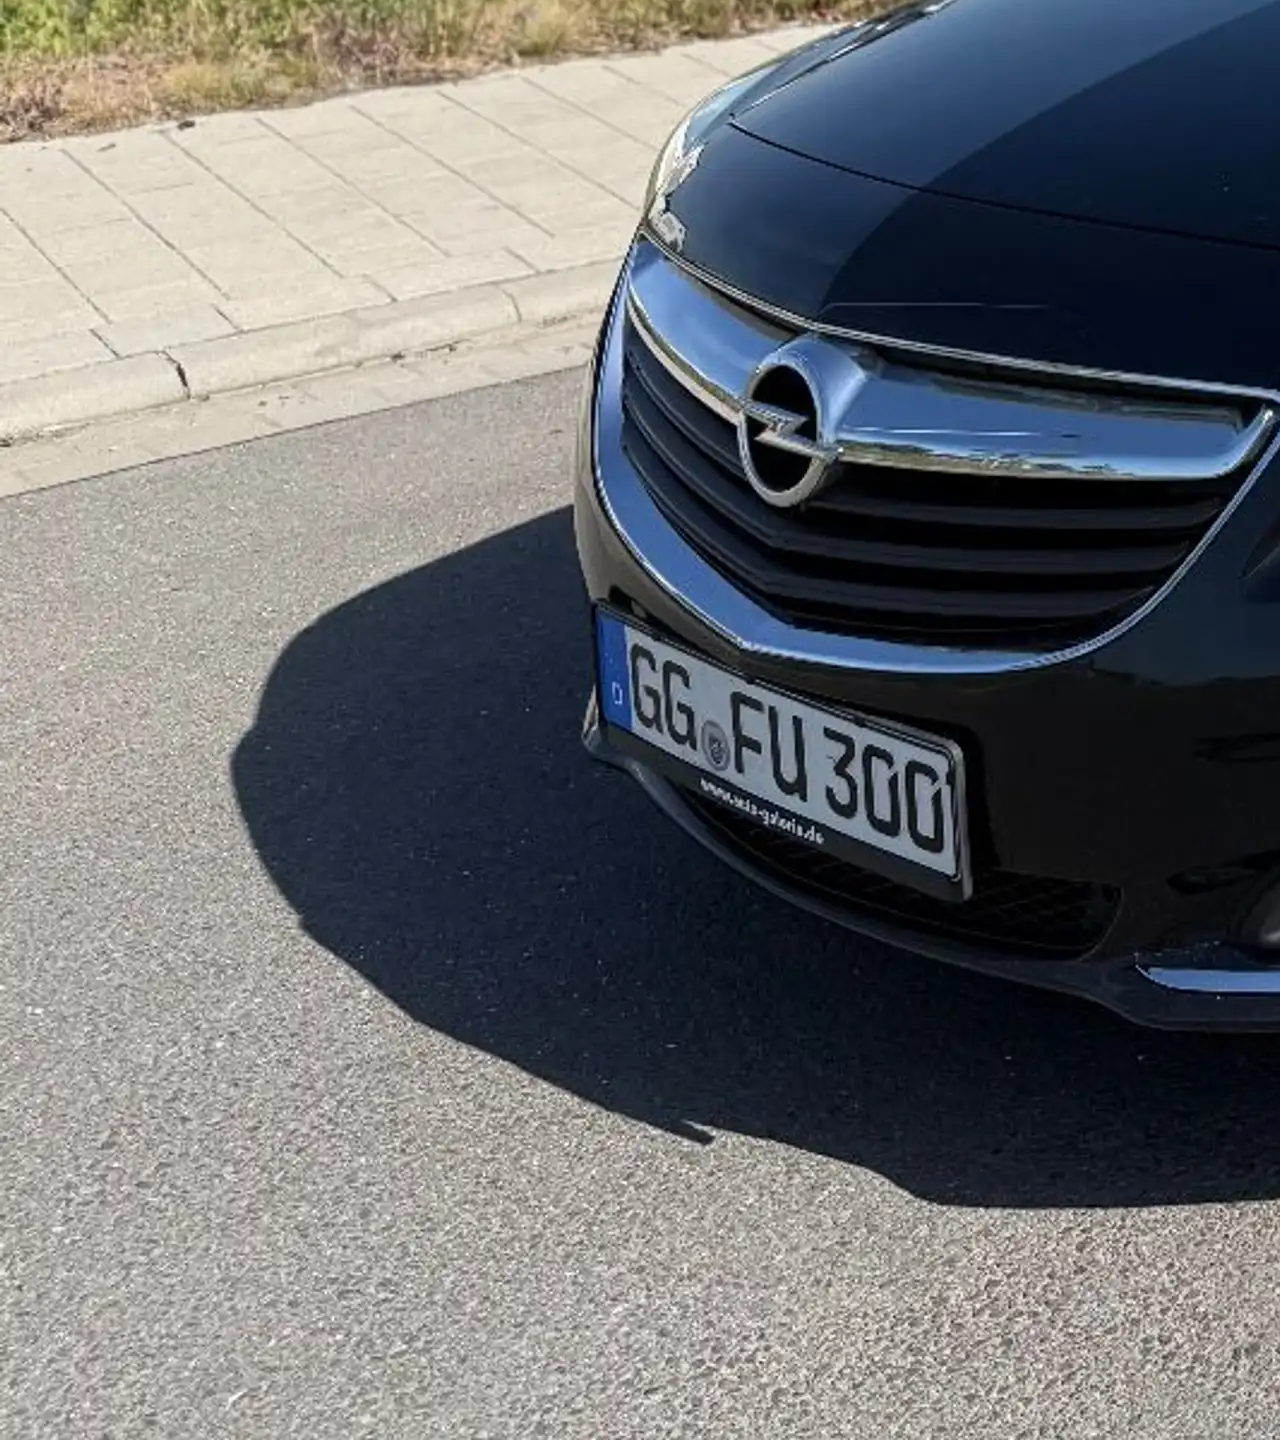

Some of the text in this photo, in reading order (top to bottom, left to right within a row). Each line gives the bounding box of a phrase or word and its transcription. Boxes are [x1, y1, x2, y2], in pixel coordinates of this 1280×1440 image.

[611, 680, 623, 705] D
[631, 644, 945, 854] GG FU 300
